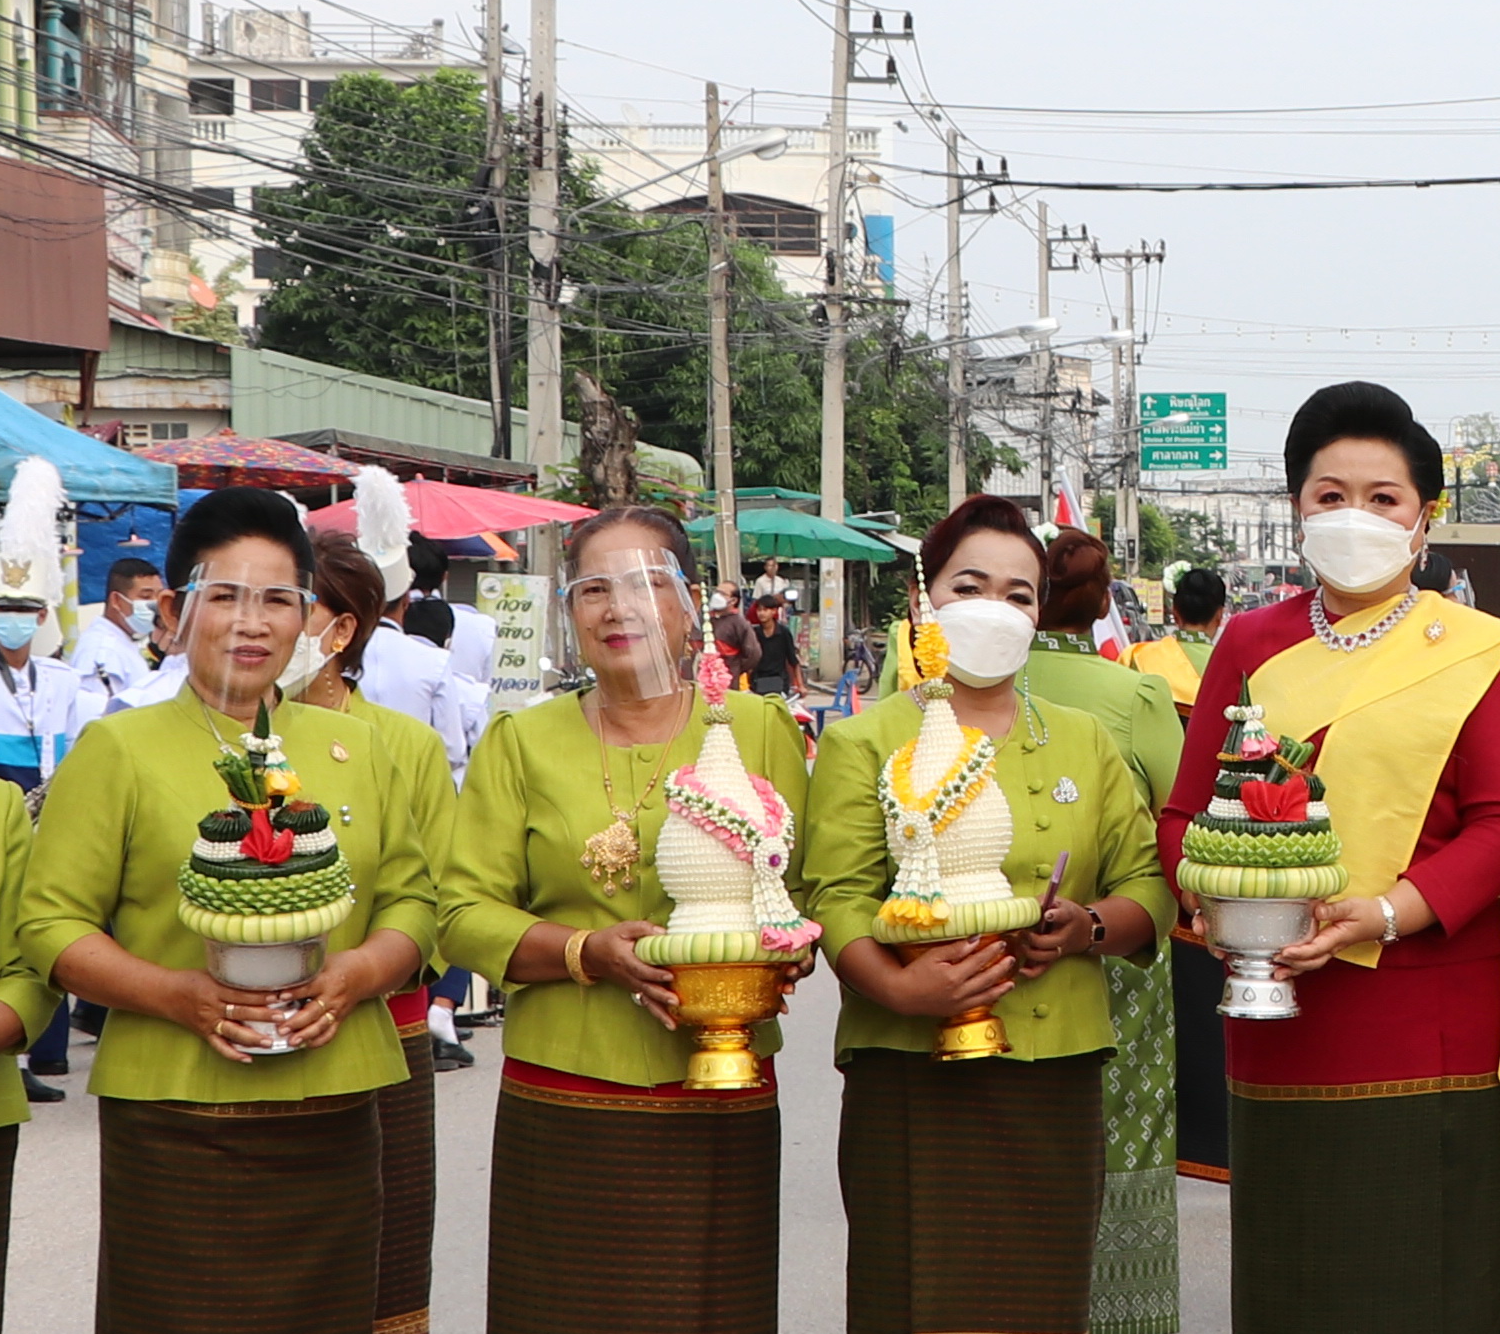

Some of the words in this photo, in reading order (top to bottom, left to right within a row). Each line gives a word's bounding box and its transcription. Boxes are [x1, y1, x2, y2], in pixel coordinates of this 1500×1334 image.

[1169, 394, 1211, 410] พิษณุโลก
[1152, 450, 1200, 461] ศาลากลาง
[498, 648, 526, 668] เรือ
